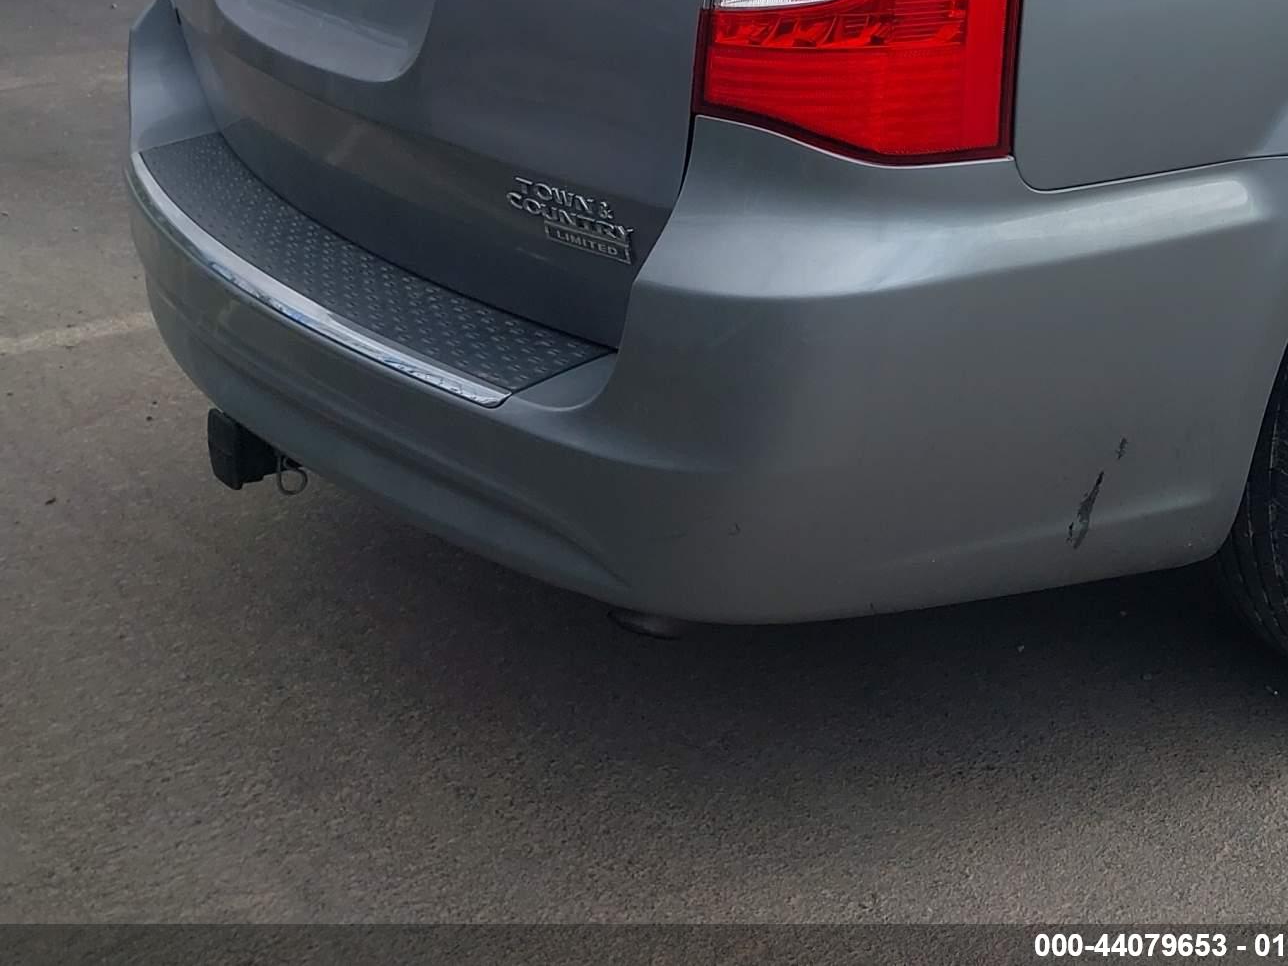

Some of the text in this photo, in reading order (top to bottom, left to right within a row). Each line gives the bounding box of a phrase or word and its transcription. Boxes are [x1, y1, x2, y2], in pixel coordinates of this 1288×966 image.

[505, 191, 636, 241] COUNTRY
[513, 177, 614, 220] TOWN &
[556, 231, 619, 256] LIMITED
